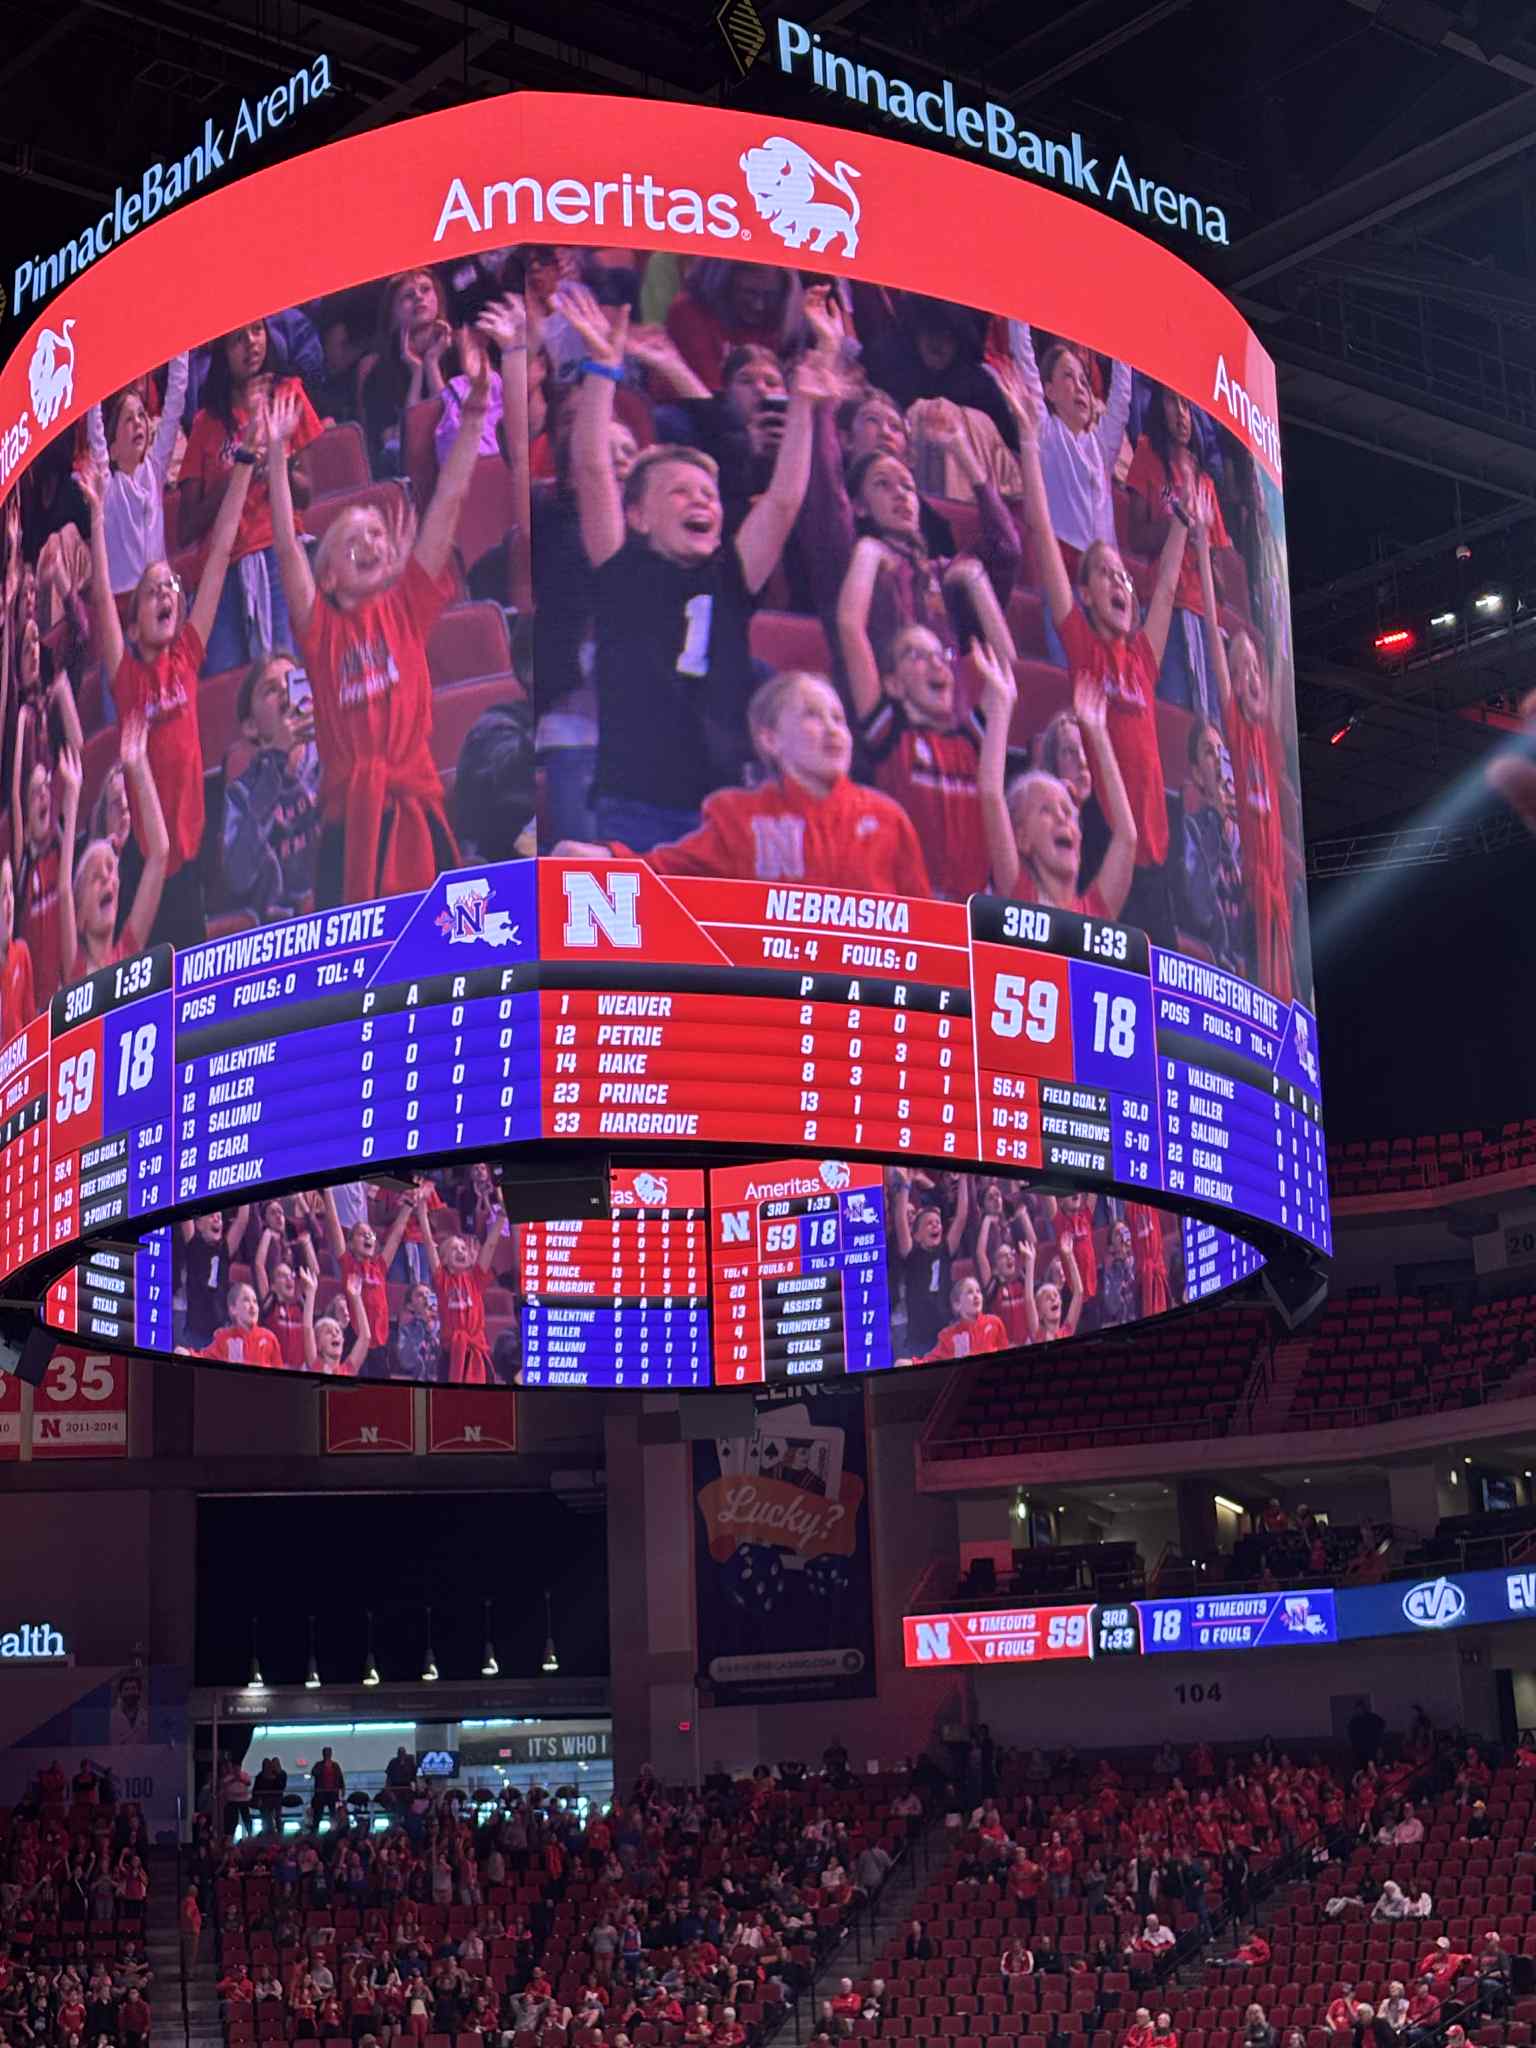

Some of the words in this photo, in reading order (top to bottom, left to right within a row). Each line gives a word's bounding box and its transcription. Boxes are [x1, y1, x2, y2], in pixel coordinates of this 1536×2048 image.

[228, 53, 332, 160] Arena
[434, 174, 740, 241] Ameritas
[1107, 156, 1231, 246] Arena
[0, 411, 29, 485] itas
[676, 594, 712, 677] 1
[752, 815, 805, 879] N
[454, 900, 484, 938] N
[562, 872, 642, 948] N
[765, 888, 909, 934] NEBRASKA
[181, 918, 323, 986] NORTHWESTERN
[325, 905, 386, 948] STATE
[1003, 906, 1050, 943] 3RD
[1083, 922, 1127, 960] 1:33
[762, 937, 800, 961] TOL:
[804, 940, 818, 961] 4
[842, 944, 901, 970] FOULS:
[905, 951, 918, 972] 0
[65, 982, 94, 1022] 3RD
[114, 956, 152, 999] 1:33
[182, 994, 216, 1023] POSS
[233, 975, 281, 1008] FOULS:
[285, 973, 297, 995] 0
[316, 962, 348, 987] TOL:
[353, 957, 365, 978] 4
[800, 976, 813, 996] P
[848, 981, 860, 1001] A
[894, 986, 907, 1006] R
[939, 991, 951, 1010] F
[1159, 954, 1251, 1016] NORTHWESTERN
[1253, 991, 1278, 1031] STATE
[561, 996, 569, 1015] 1
[597, 996, 672, 1017] WEAVER
[800, 1005, 813, 1025] 2
[848, 1009, 860, 1028] 2
[894, 1014, 906, 1034] 0
[939, 1019, 951, 1039] 0
[990, 972, 1059, 1044] 59
[1092, 991, 1137, 1060] 18
[1161, 999, 1190, 1025] POSS
[1203, 1012, 1233, 1042] FOULS:
[1250, 1032, 1266, 1058] TOL:
[184, 1063, 193, 1084] 0
[208, 1041, 277, 1077] VALENTINE
[555, 1026, 576, 1045] 12
[597, 1026, 663, 1047] PETRIE
[800, 1035, 813, 1055] 9
[849, 1039, 862, 1058] 0
[895, 1044, 907, 1063] 3
[940, 1048, 951, 1068] 0
[56, 1048, 96, 1125] 59
[117, 1022, 157, 1097] 18
[555, 1054, 576, 1073] 14
[598, 1054, 648, 1074] HAKE
[802, 1063, 815, 1082] 8
[849, 1066, 862, 1086] 3
[898, 1071, 906, 1090] 1
[943, 1076, 950, 1095] 1
[1167, 1062, 1175, 1080] 0
[1188, 1067, 1234, 1100] VALENTINE
[182, 1092, 196, 1113] 12
[208, 1076, 254, 1106] MILLER
[553, 1084, 579, 1104] 23
[598, 1084, 668, 1105] PRINCE
[800, 1092, 818, 1111] 13
[854, 1096, 861, 1115] 1
[897, 1100, 910, 1119] 5
[942, 1104, 954, 1124] 0
[993, 1077, 1025, 1098] 56.4
[1043, 1086, 1071, 1106] FIELD
[1072, 1092, 1097, 1111] GOAL
[1122, 1100, 1149, 1121] 30.0
[1167, 1089, 1178, 1109] 12
[1189, 1094, 1223, 1122] MILLER
[138, 1124, 162, 1149] 30.0
[182, 1120, 195, 1140] 13
[208, 1102, 261, 1133] SALUMU
[553, 1113, 580, 1133] 33
[600, 1113, 698, 1135] HARGROVE
[803, 1121, 816, 1141] 2
[854, 1124, 862, 1144] 1
[898, 1128, 911, 1148] 3
[943, 1133, 955, 1153] 2
[992, 1108, 1029, 1130] 10-13
[1042, 1117, 1067, 1134] FREE
[1069, 1121, 1110, 1142] THROWS
[1125, 1130, 1149, 1152] 5-10
[1168, 1115, 1180, 1135] 13
[1191, 1121, 1229, 1149] SALUMU
[139, 1155, 162, 1179] 5-10
[179, 1148, 197, 1169] 22
[208, 1134, 249, 1161] GEARA
[996, 1138, 1028, 1160] 5-13
[1051, 1148, 1091, 1169] 3-POINT
[1092, 1154, 1105, 1171] FG
[1130, 1160, 1148, 1180] 1-8
[1168, 1142, 1183, 1163] 22
[1192, 1148, 1223, 1174] GEARA
[142, 1185, 159, 1208] 1-8
[179, 1176, 197, 1198] 24
[208, 1158, 263, 1190] RIDEAUX
[744, 1177, 820, 1200] Ameritas
[1169, 1169, 1184, 1190] 24
[1194, 1175, 1233, 1203] RIDEAUX
[721, 1210, 750, 1243] N
[767, 1202, 789, 1217] 3RD
[807, 1197, 831, 1212] 1:33
[766, 1223, 797, 1252] 59
[810, 1219, 837, 1247] 18
[854, 1234, 875, 1247] POSS
[777, 1276, 827, 1295] REBOUNDS
[783, 1297, 823, 1314] ASSISTS
[777, 1317, 831, 1336] TURNOVERS
[787, 1339, 821, 1354] STEALS
[46, 1356, 114, 1401] 35
[787, 1359, 823, 1375] BLOCKS
[41, 1418, 61, 1438] N
[65, 1422, 119, 1433] 2011-2014
[361, 1427, 379, 1443] N
[464, 1426, 482, 1442] N
[718, 1486, 846, 1547] Lucky?
[915, 1621, 951, 1661] N
[968, 1618, 977, 1633] 4
[980, 1614, 1037, 1633] TIMEOUTS
[1047, 1615, 1086, 1649] 59
[1101, 1609, 1129, 1627] 3RD
[1152, 1610, 1181, 1642] 18
[1196, 1603, 1204, 1619] 3
[1208, 1599, 1267, 1618] TIMEOUTS
[1408, 1577, 1458, 1622] CVA
[0, 1624, 66, 1658] alth
[985, 1642, 994, 1658] 0
[998, 1639, 1035, 1657] FOULS
[1100, 1627, 1135, 1650] 1:33
[1200, 1629, 1209, 1644] 0
[1213, 1626, 1251, 1643] FOULS
[1173, 1682, 1222, 1704] 104
[528, 1736, 558, 1757] IT'S
[562, 1735, 597, 1755] WHO
[124, 1777, 153, 1799] 100
